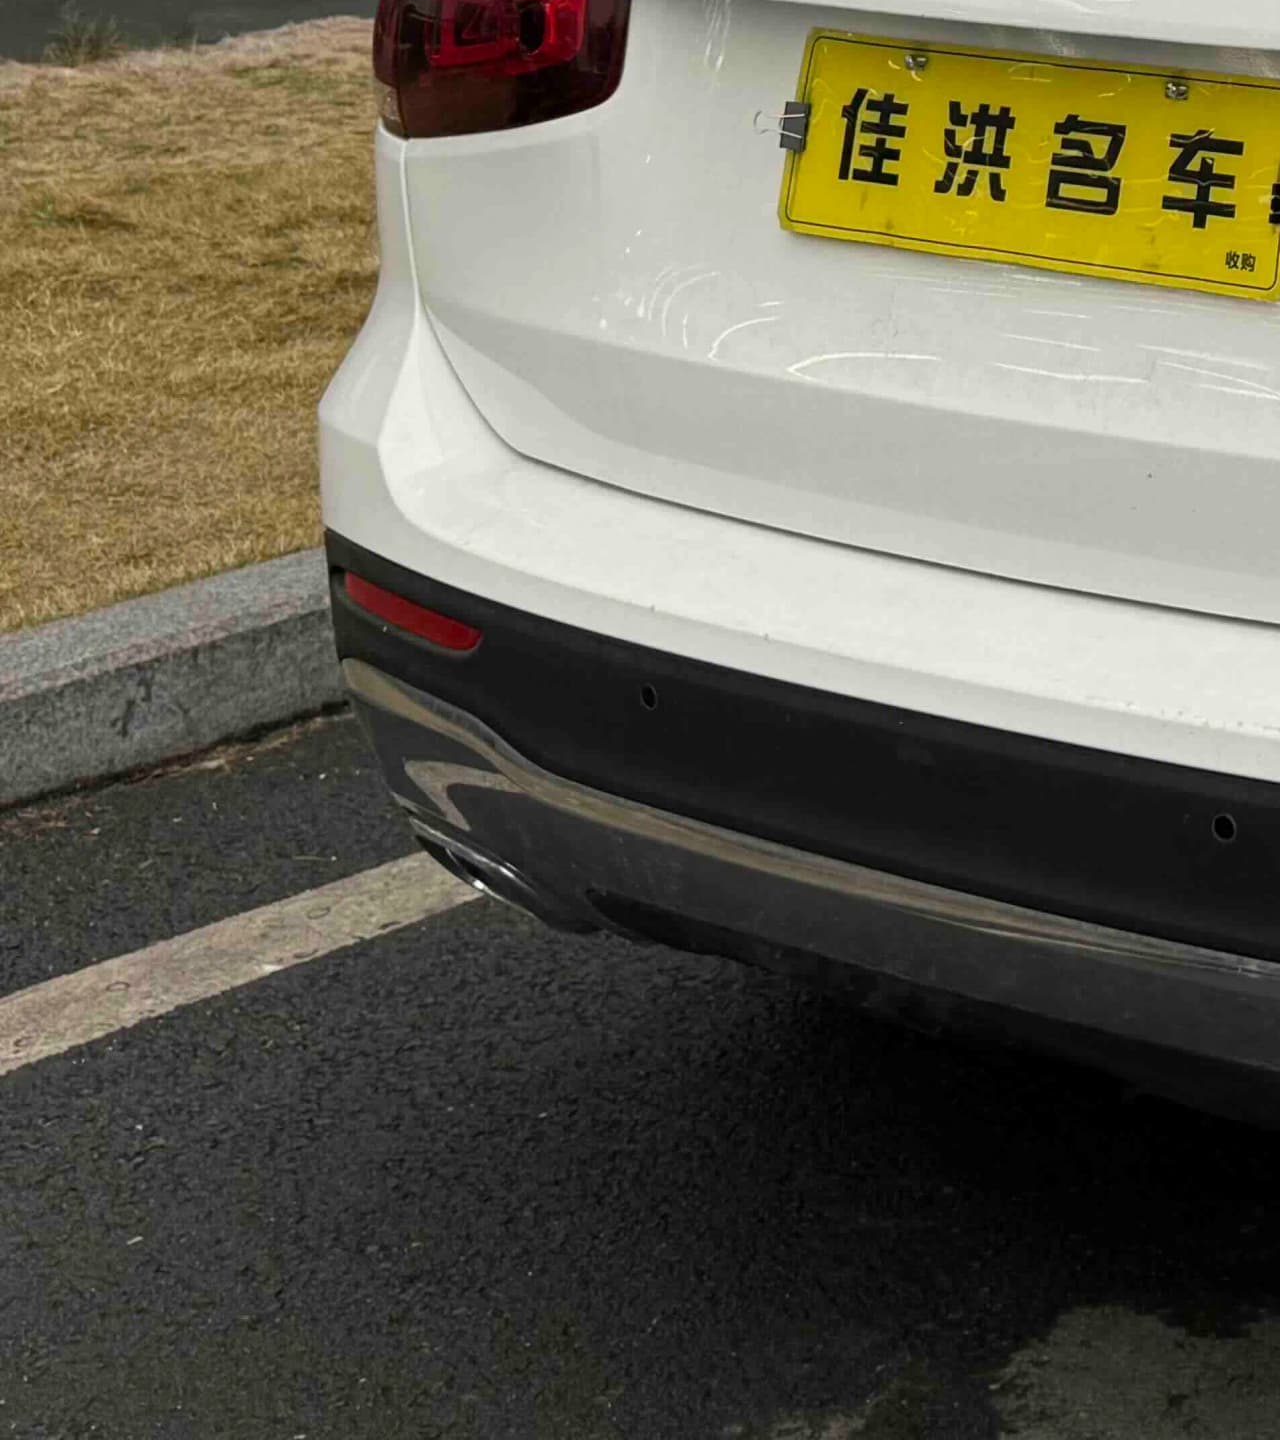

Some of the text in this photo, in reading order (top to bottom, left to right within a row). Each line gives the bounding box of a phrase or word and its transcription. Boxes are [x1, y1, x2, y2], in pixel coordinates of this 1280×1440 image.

[838, 88, 1245, 229] 佳洪名车
[1224, 250, 1257, 273] 收购
